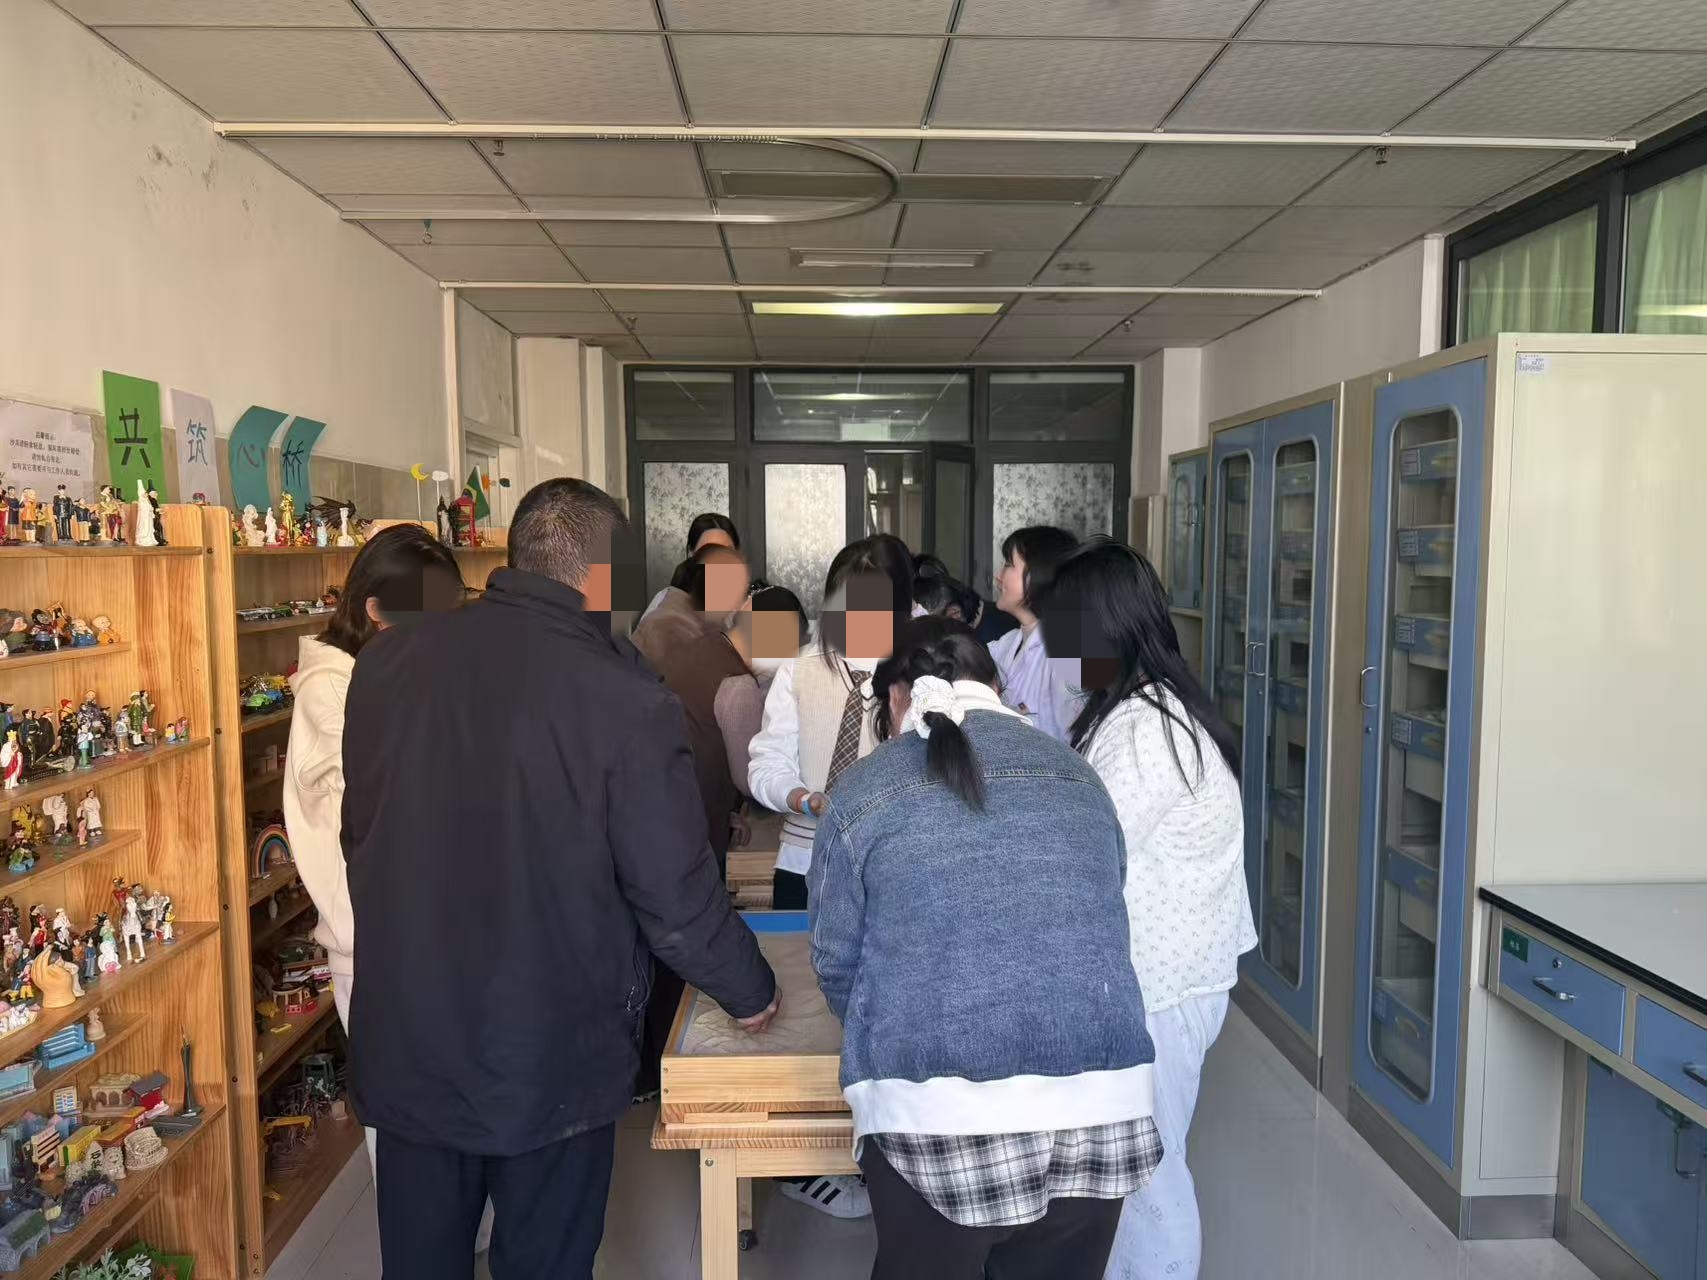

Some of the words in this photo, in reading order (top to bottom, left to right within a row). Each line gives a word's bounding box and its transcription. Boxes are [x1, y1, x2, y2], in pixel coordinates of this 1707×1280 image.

[114, 408, 151, 468] 共
[186, 419, 208, 466] 筑
[236, 444, 266, 468] 心
[283, 440, 304, 488] 桥
